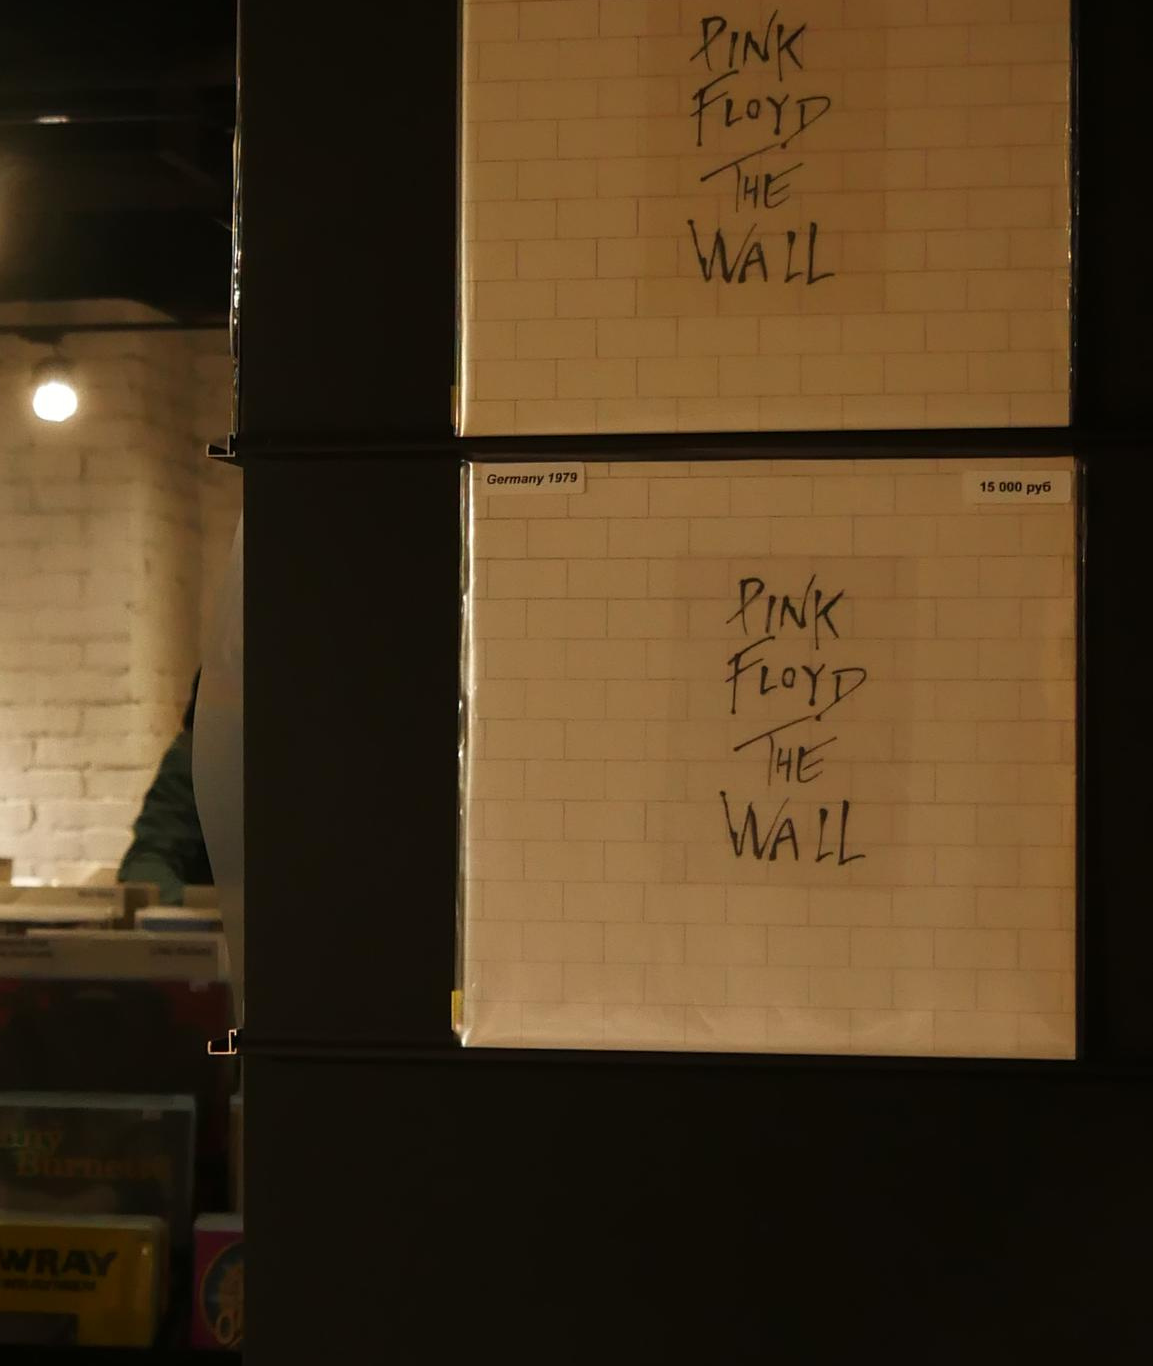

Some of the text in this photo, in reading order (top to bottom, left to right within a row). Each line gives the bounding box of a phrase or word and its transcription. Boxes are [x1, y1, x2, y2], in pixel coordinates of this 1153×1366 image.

[690, 10, 807, 82] PINK
[692, 70, 831, 148] FLOYD
[700, 143, 804, 212] THE
[688, 219, 834, 285] WALL
[487, 472, 577, 486] Germany 1979
[979, 481, 1051, 495] 15 000 руб
[725, 574, 844, 650] PINK
[725, 636, 867, 721] FLOYD
[733, 716, 838, 785] THE
[720, 791, 867, 866] WALL
